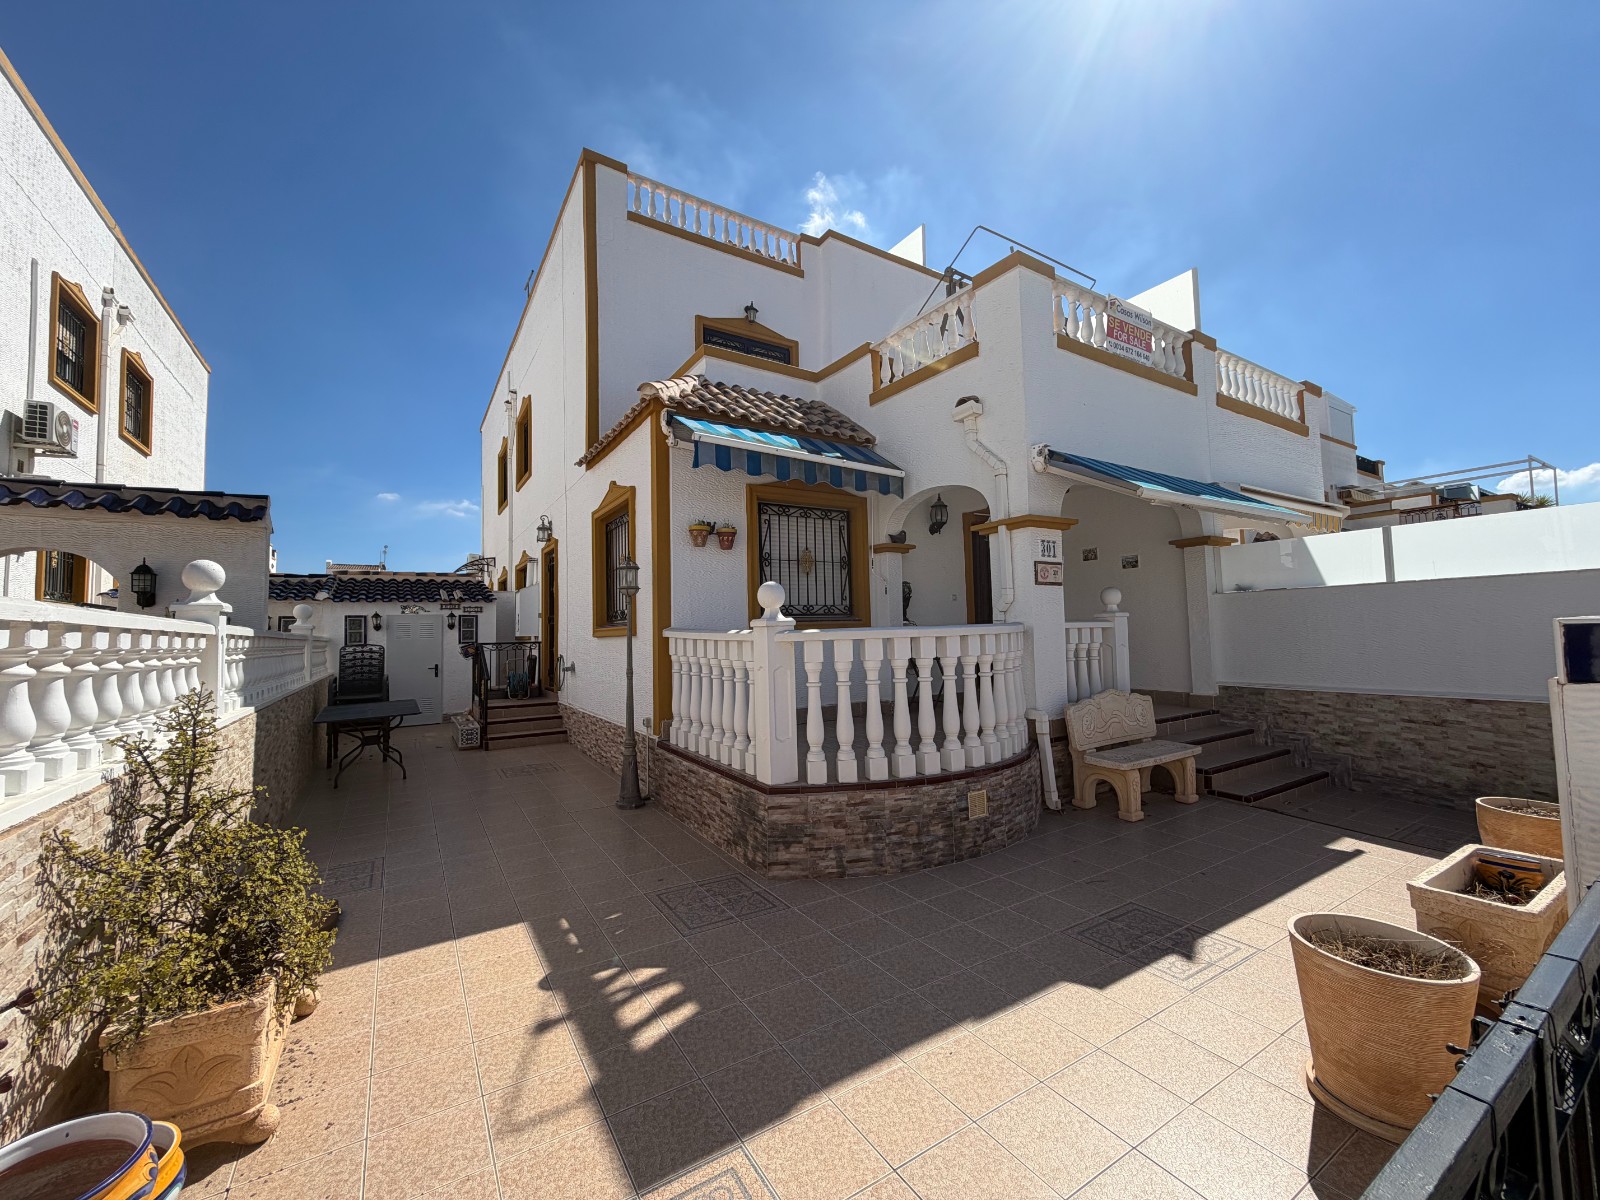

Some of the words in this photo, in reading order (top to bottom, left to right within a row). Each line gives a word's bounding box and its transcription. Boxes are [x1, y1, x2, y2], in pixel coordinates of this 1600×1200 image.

[1116, 304, 1133, 319] Casas
[1134, 311, 1152, 327] Wilson
[1108, 316, 1120, 329] SE
[1122, 321, 1153, 343] VENDE
[1113, 329, 1129, 343] FOR
[1129, 335, 1147, 350] SALE
[1040, 539, 1057, 559] 301
